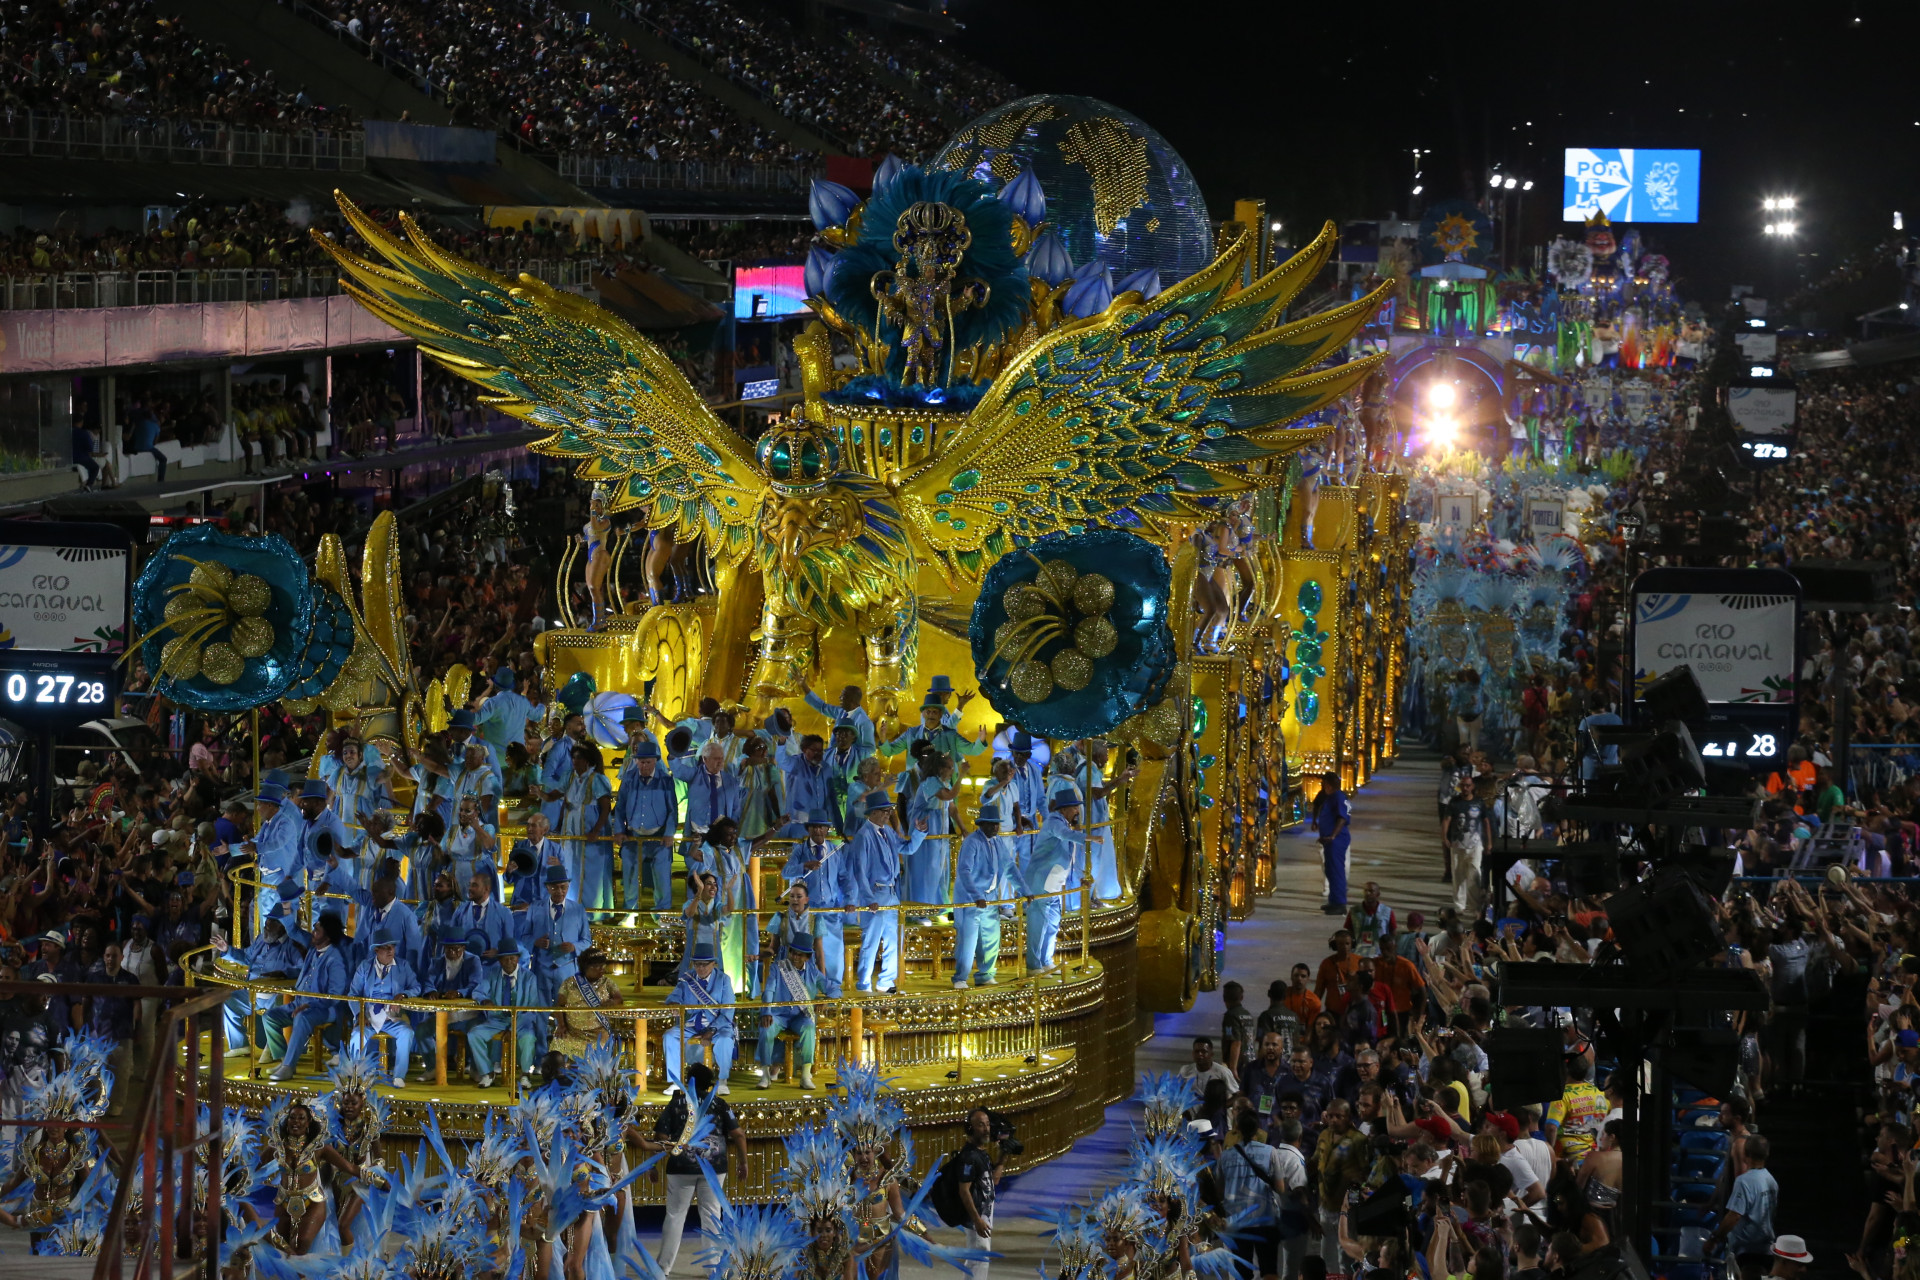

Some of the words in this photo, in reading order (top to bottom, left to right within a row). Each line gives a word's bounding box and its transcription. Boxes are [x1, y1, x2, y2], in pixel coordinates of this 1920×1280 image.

[1577, 161, 1623, 176] POR
[1575, 177, 1601, 193] TE
[1575, 194, 1601, 209] LA
[1753, 443, 1774, 458] 27
[1532, 509, 1560, 527] PORTELA
[1657, 642, 1773, 661] carnaval
[36, 675, 75, 703] 27
[77, 682, 105, 703] 28
[1745, 734, 1776, 757] 28
